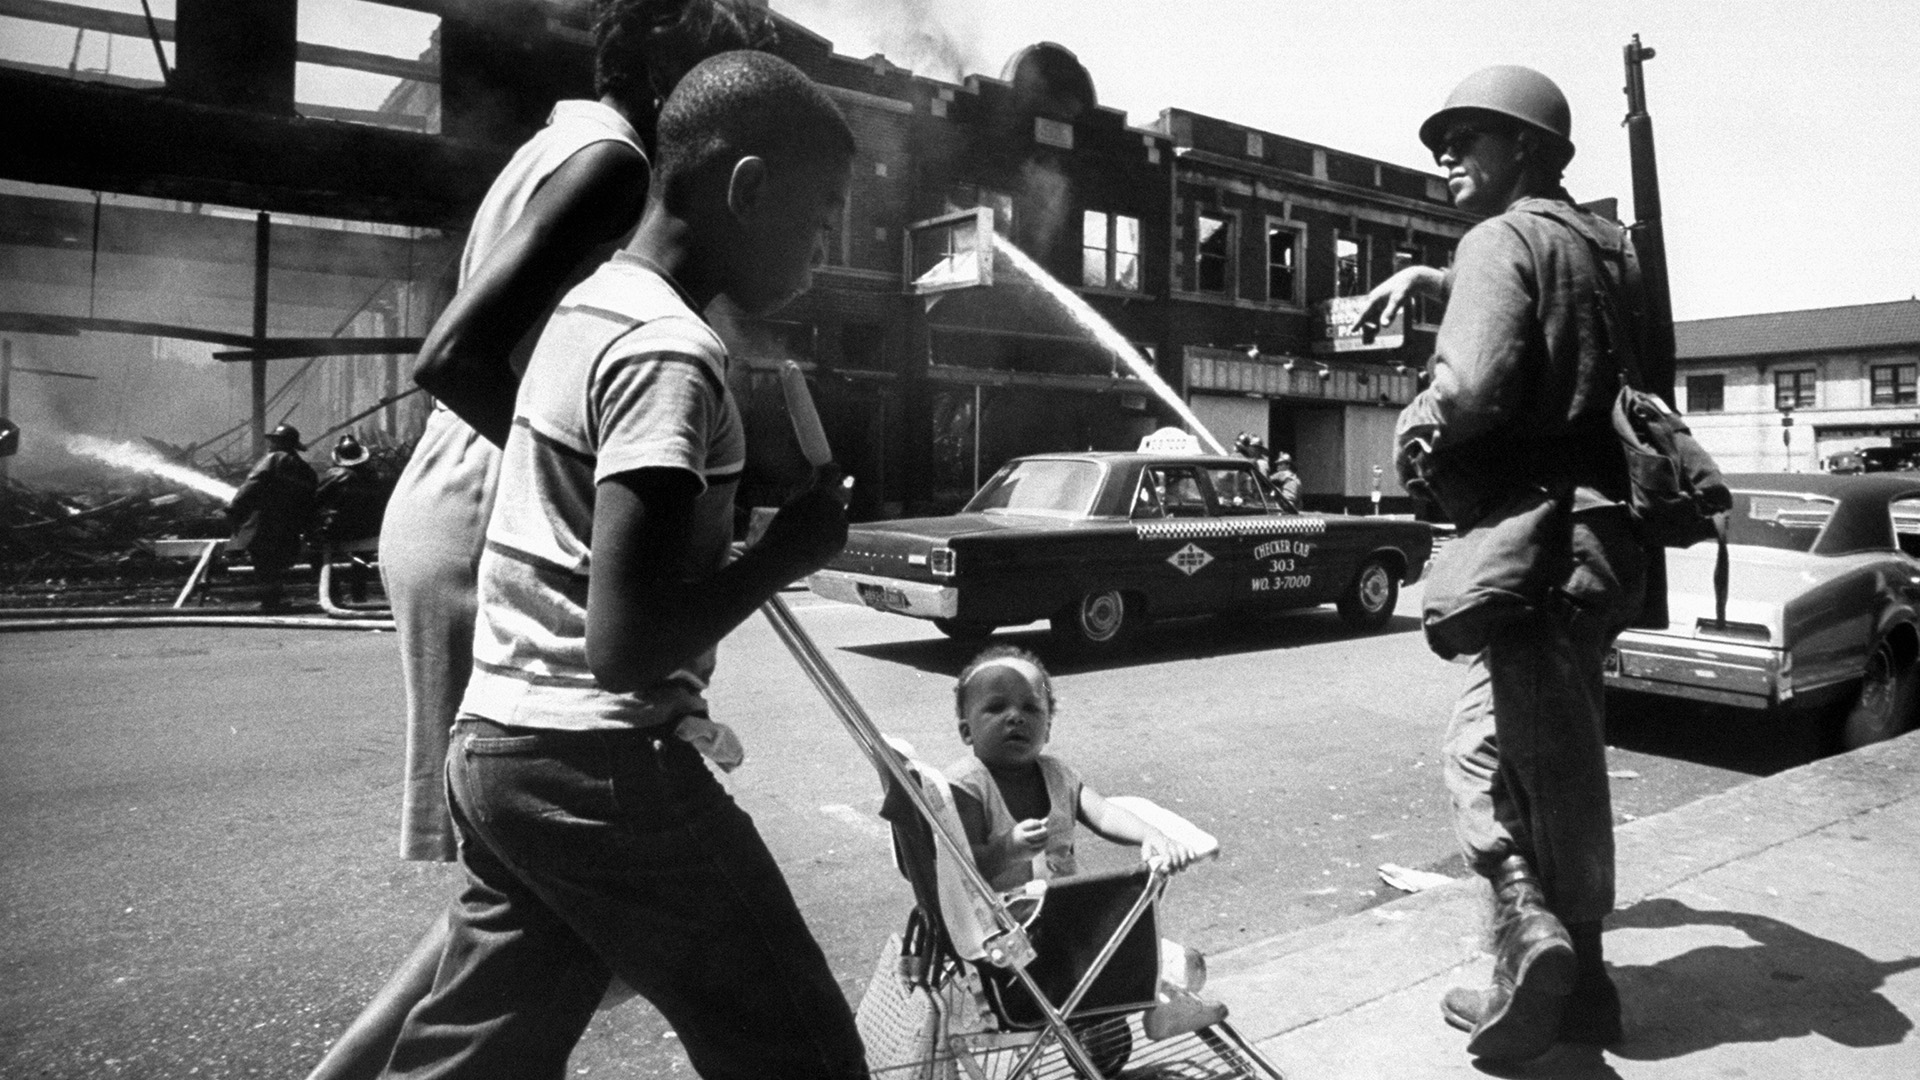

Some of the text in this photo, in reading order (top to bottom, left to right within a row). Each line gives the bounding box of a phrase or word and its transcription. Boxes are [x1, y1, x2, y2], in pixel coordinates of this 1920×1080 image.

[1254, 539, 1310, 560] CHECKER CAB
[1269, 559, 1295, 572] 303
[1272, 575, 1311, 590] 3-7000
